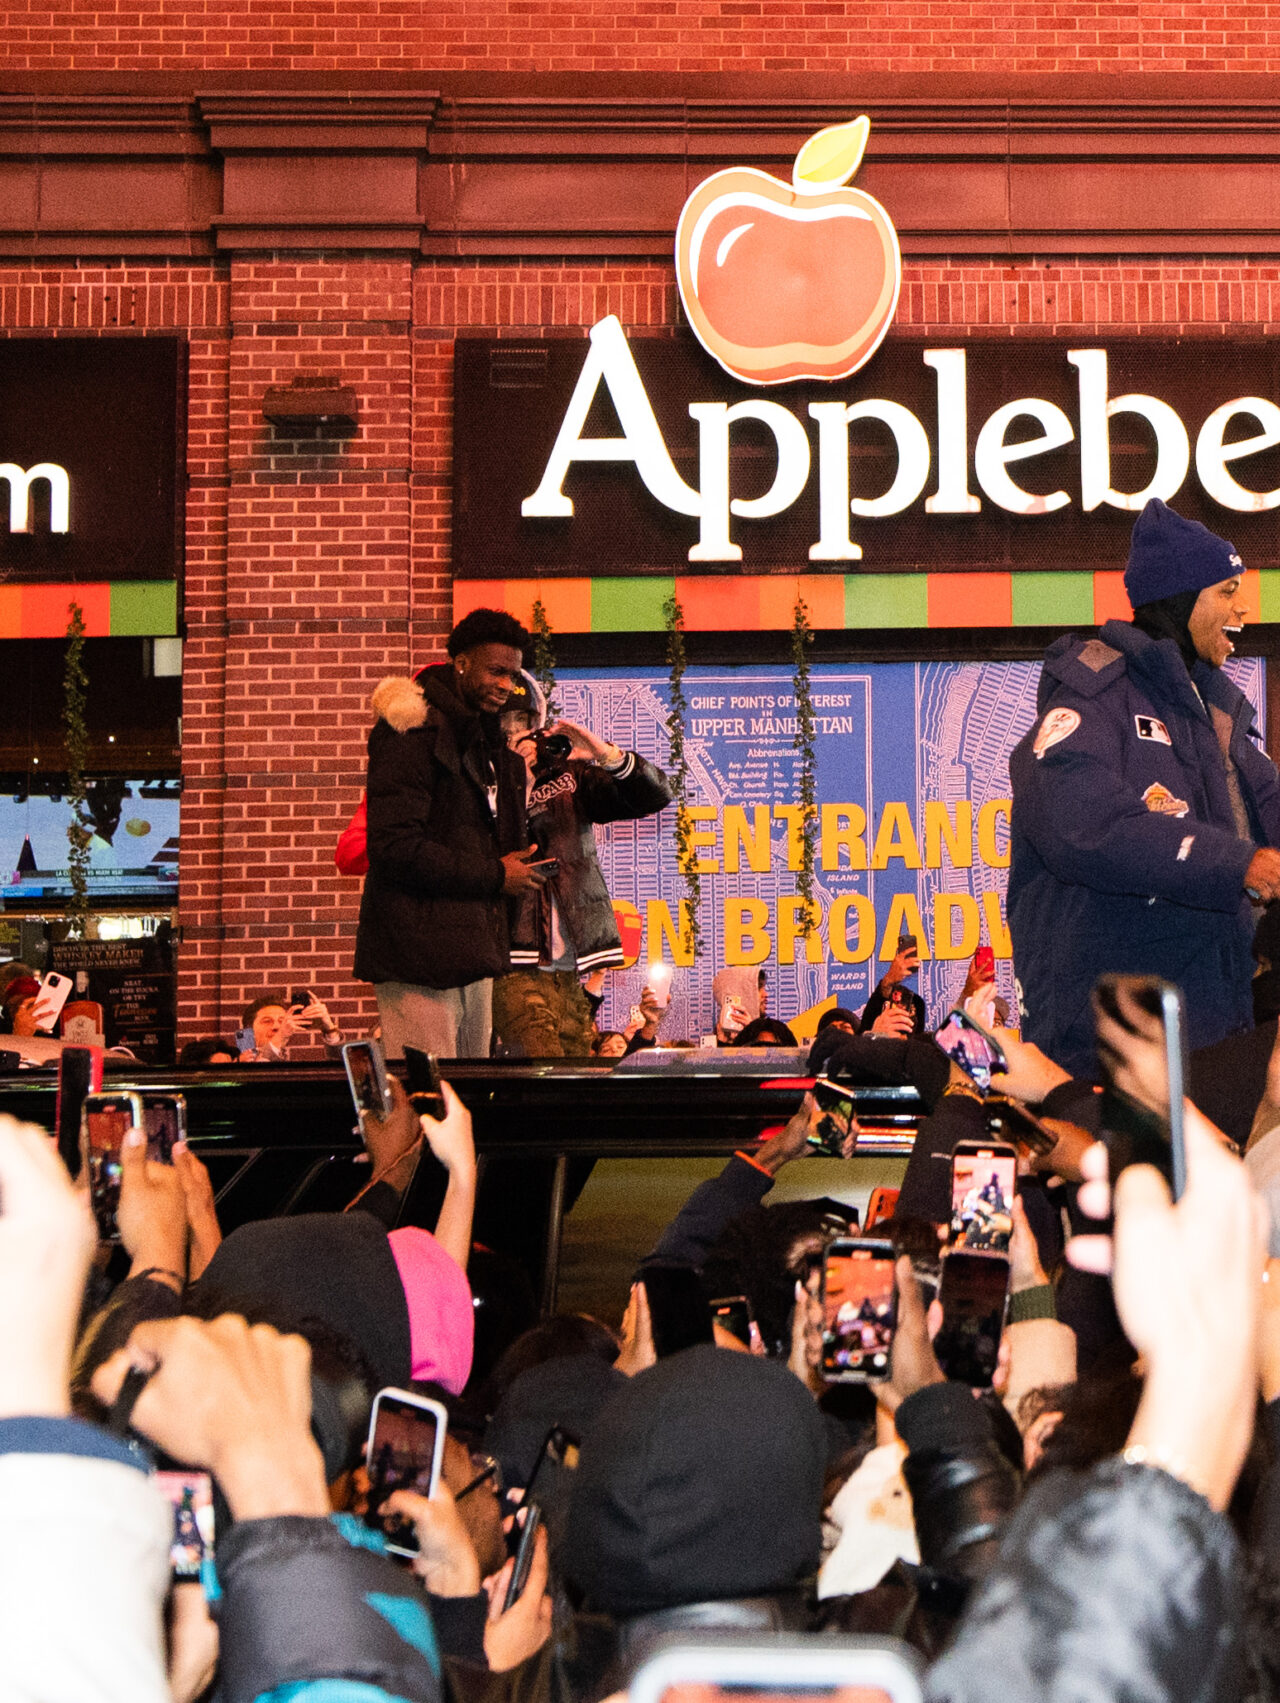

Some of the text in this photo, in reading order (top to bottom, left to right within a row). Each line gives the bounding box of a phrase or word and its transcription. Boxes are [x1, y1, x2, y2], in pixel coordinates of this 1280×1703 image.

[691, 696, 725, 710] CHIEF
[730, 695, 775, 709] POINTS
[778, 695, 792, 708] OF
[691, 716, 853, 736] UPPER MANHTTAN
[826, 874, 860, 882] ISLAND
[831, 972, 867, 981] WARDS
[831, 982, 864, 991] ISLAND
